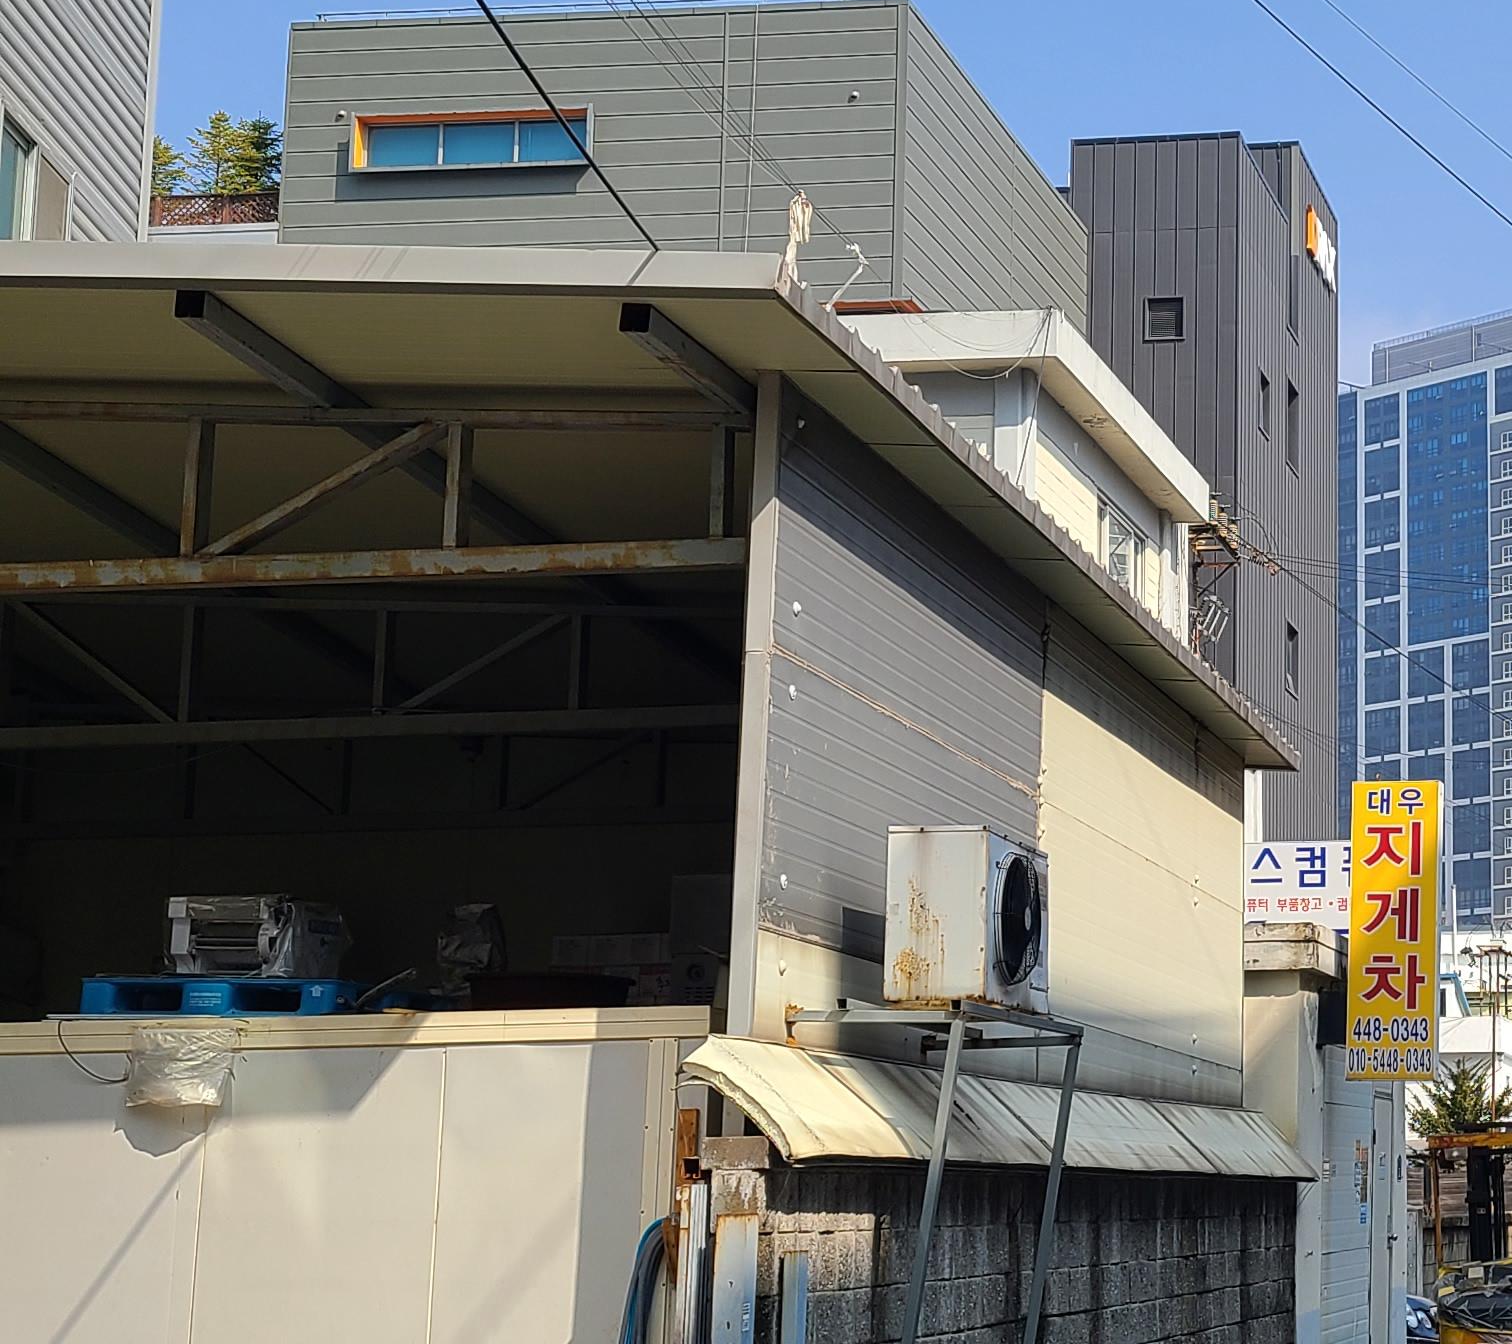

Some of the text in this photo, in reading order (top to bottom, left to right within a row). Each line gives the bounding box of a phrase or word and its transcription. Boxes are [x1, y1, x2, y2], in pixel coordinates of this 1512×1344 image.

[1367, 789, 1425, 815] 대우
[1276, 897, 1323, 912] 부품창고
[1362, 821, 1426, 1010] 지게차
[1353, 1017, 1429, 1042] 448-0343
[1348, 1047, 1432, 1073] 010-5448-0343
